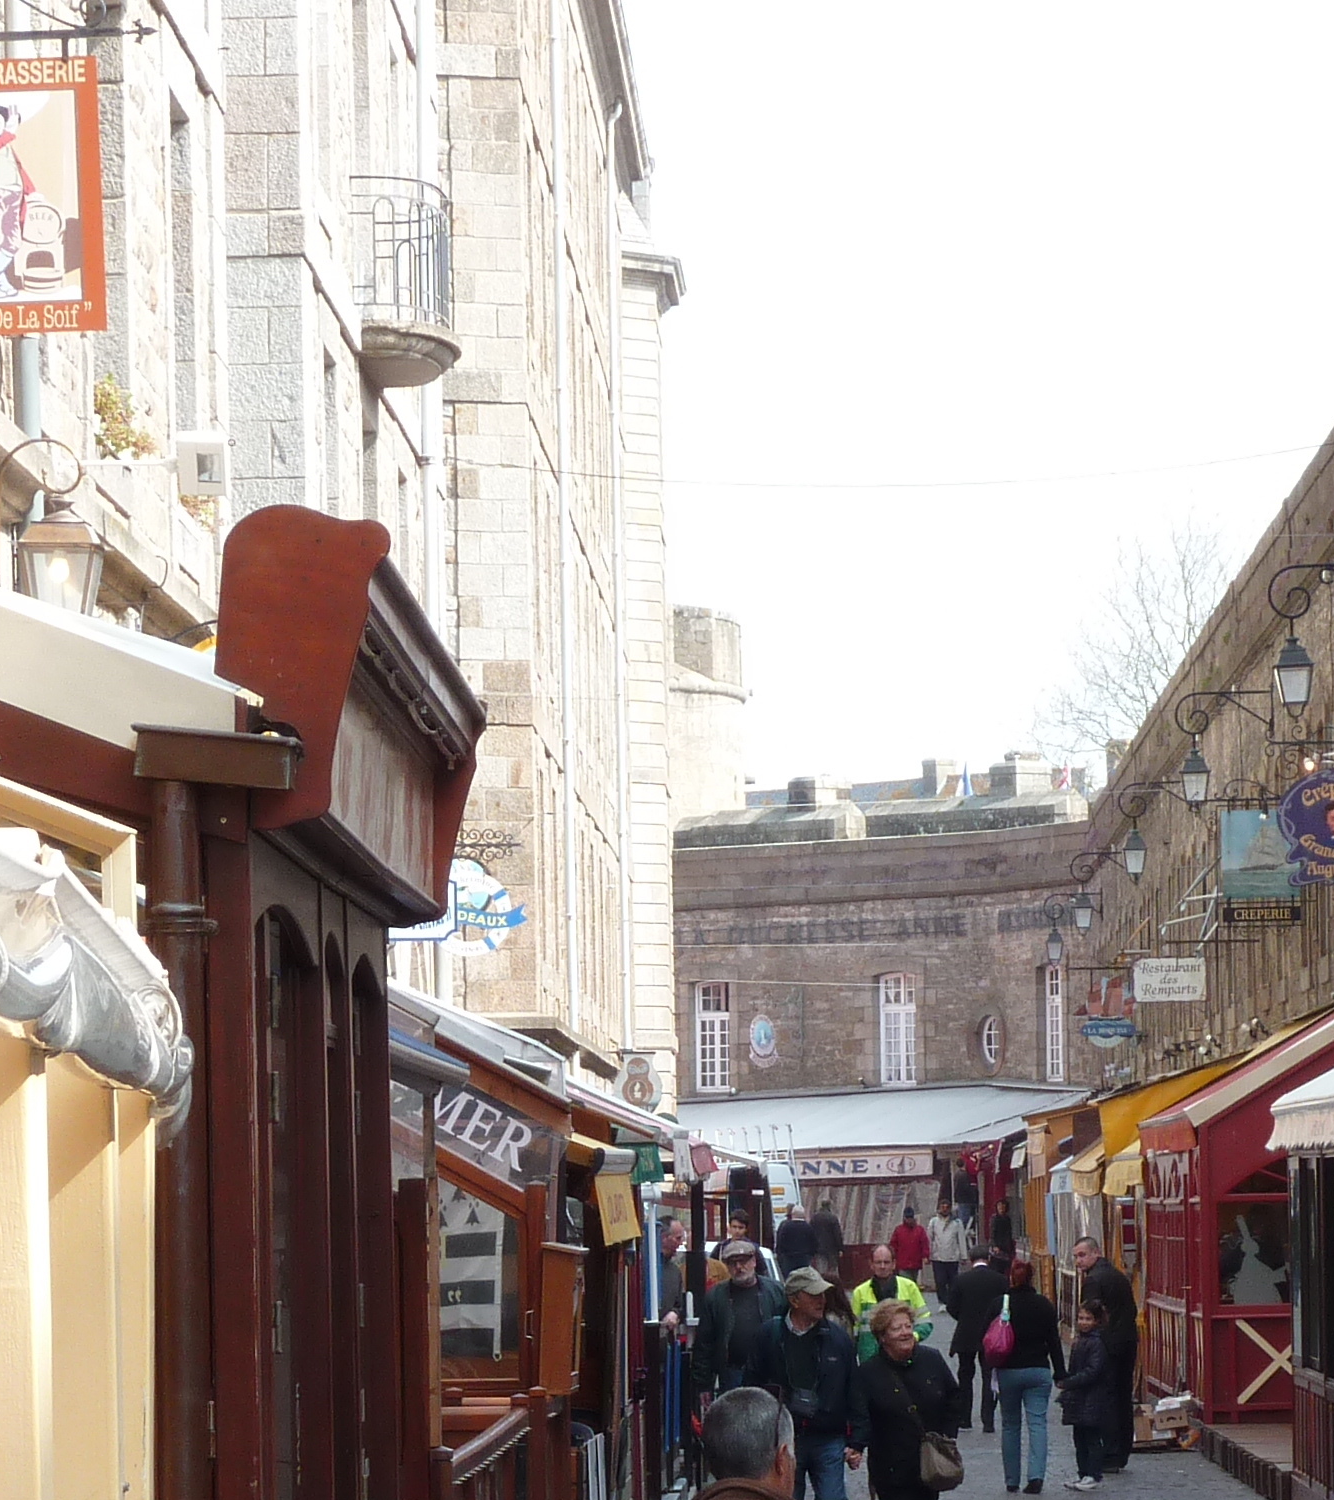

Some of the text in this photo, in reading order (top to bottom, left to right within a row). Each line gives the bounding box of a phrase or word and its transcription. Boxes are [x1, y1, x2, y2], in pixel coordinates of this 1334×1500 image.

[28, 212, 54, 223] BEER
[17, 306, 40, 330] La
[43, 302, 79, 330] Soif
[1233, 908, 1292, 920] CREPERIE
[1138, 962, 1202, 974] Restaurant
[1140, 983, 1198, 999] Remparts
